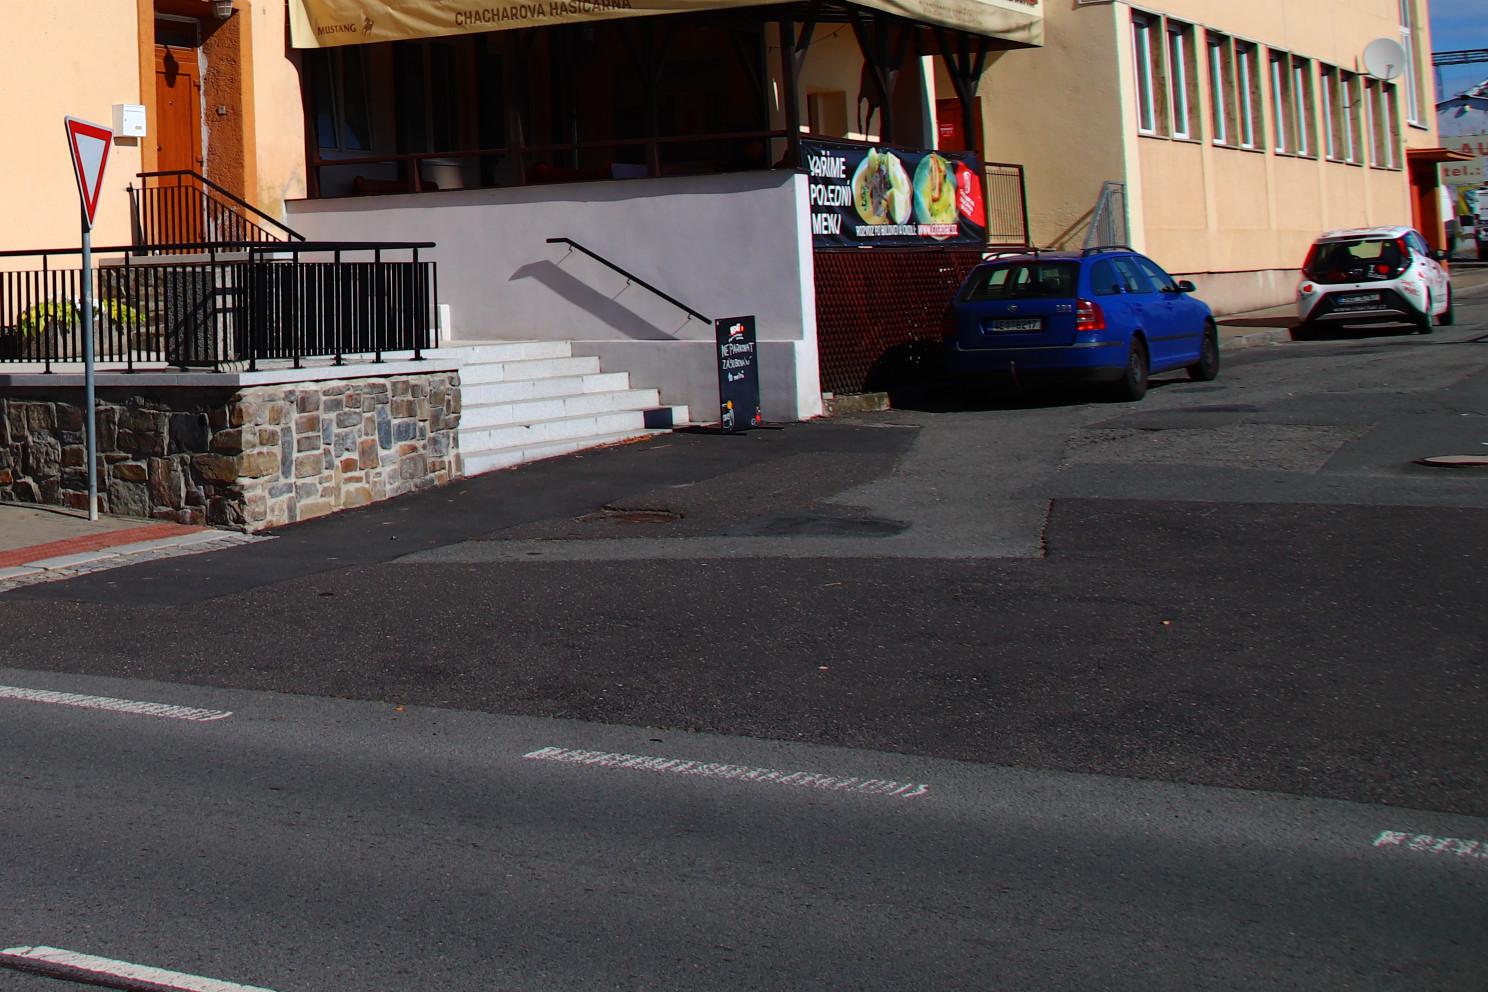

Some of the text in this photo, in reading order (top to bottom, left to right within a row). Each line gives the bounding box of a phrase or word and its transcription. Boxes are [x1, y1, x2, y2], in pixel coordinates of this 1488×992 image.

[455, 3, 546, 26] CHACHAROVA
[317, 24, 357, 37] MUSTANG
[808, 150, 846, 178] VAŘÍME
[811, 182, 852, 207] POLEDNÍ
